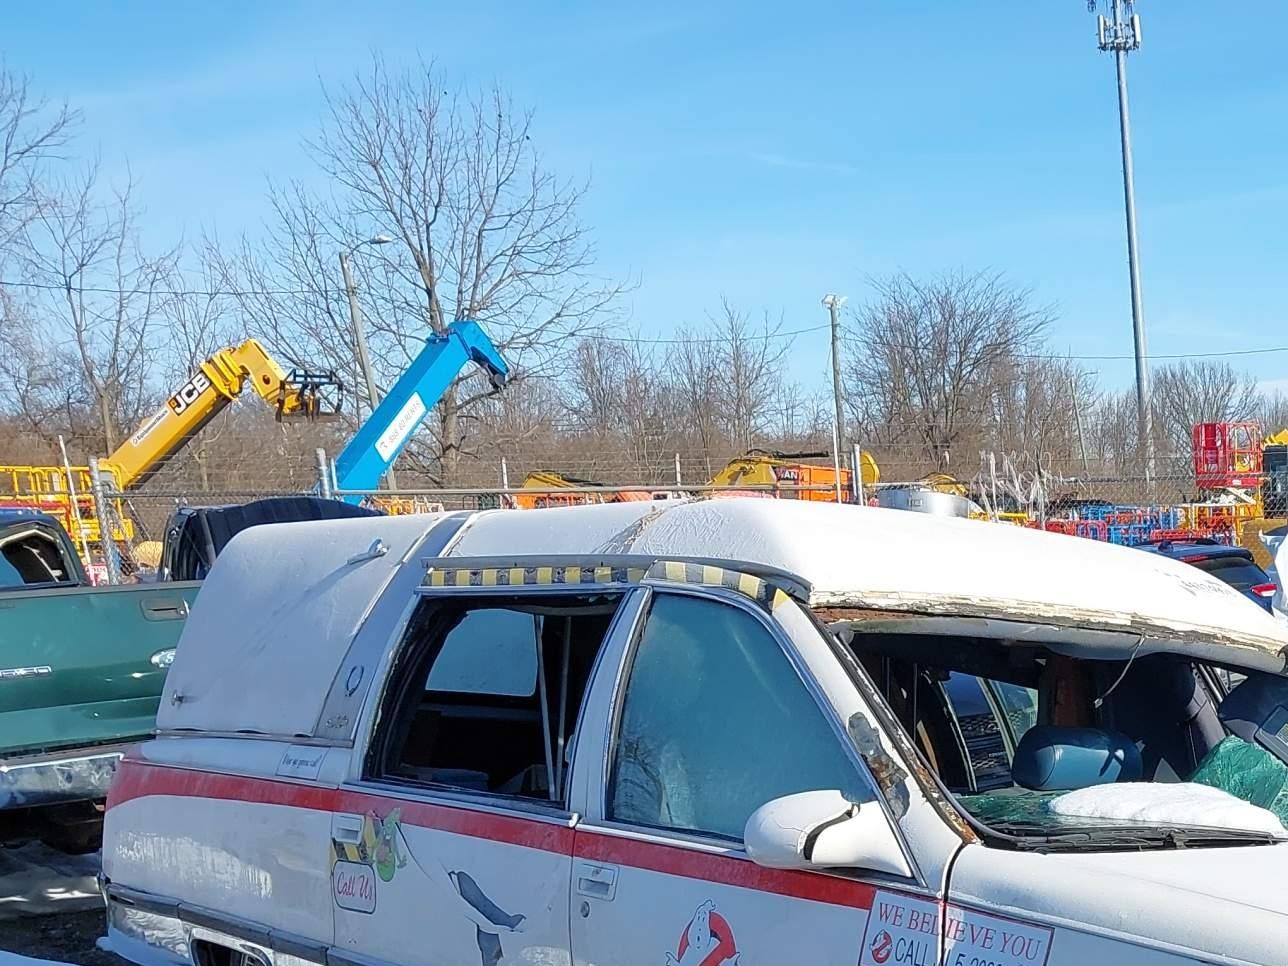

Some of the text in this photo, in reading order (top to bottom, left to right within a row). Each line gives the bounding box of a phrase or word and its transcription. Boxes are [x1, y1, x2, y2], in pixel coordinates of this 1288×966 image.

[174, 372, 211, 415] JCB
[337, 871, 373, 901] Call Us
[879, 902, 1042, 961] WE BELIEVE YOU
